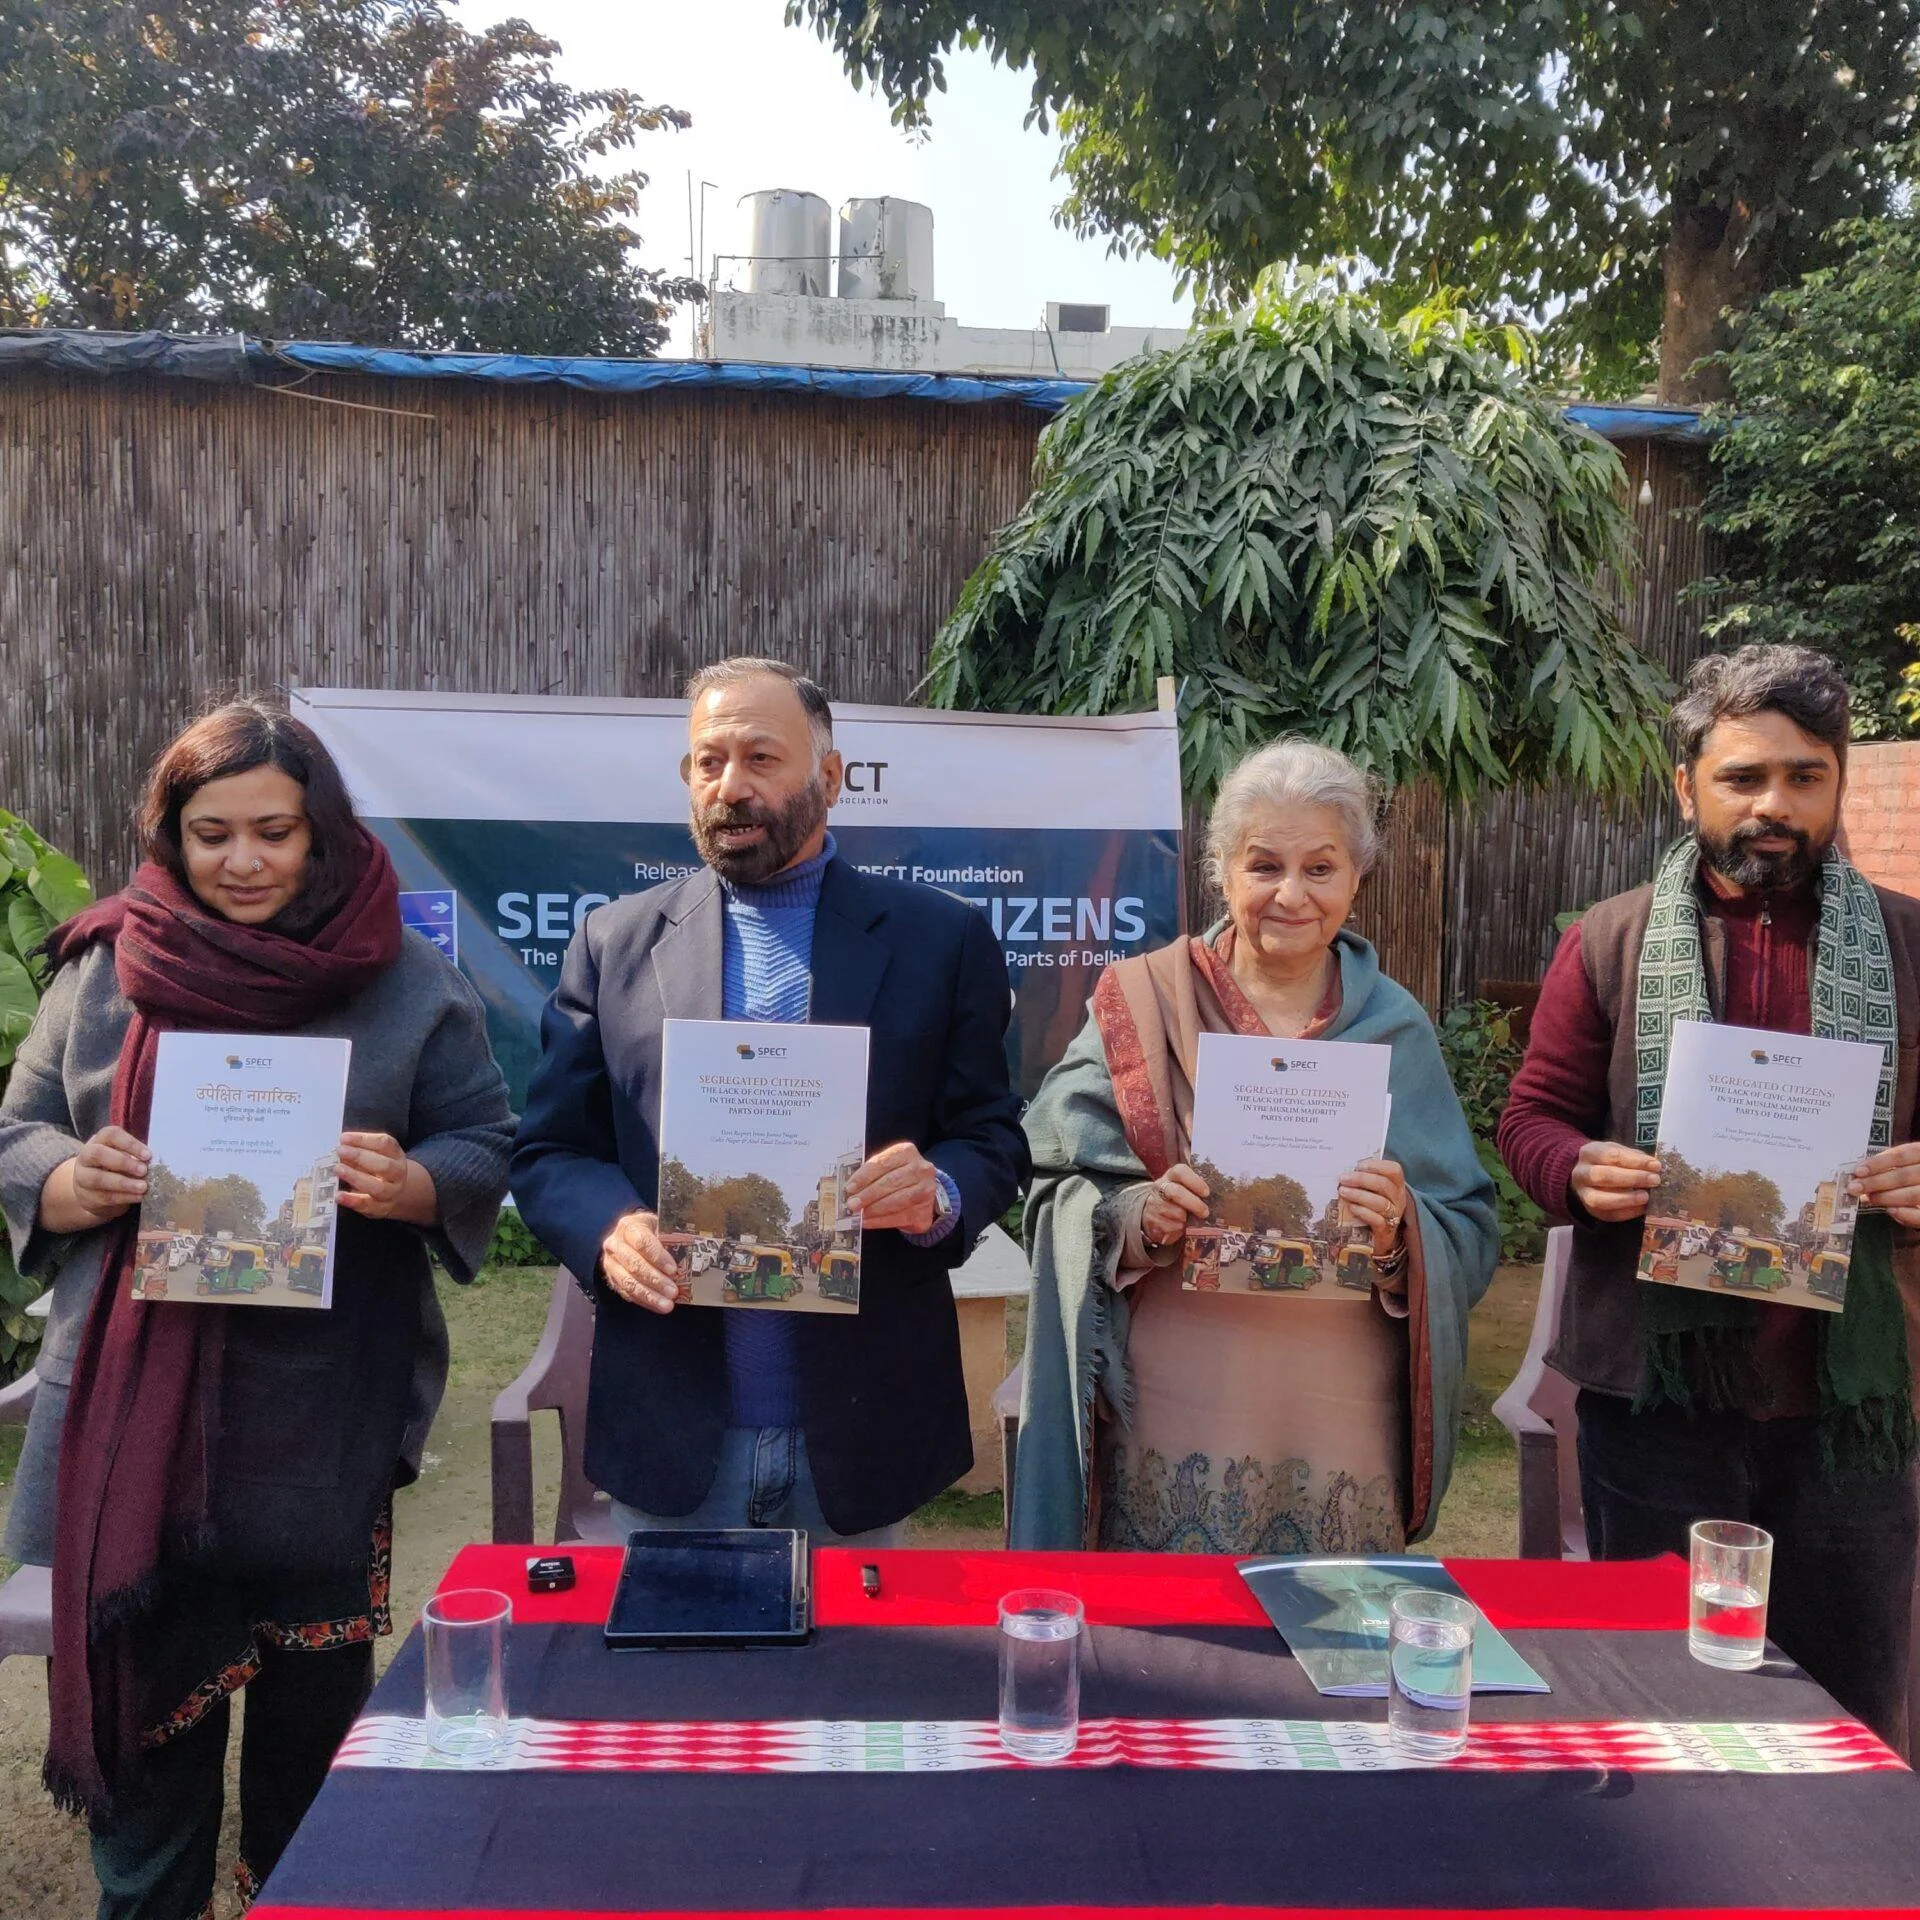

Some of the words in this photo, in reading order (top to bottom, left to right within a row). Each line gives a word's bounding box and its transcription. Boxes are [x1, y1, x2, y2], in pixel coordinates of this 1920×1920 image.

[839, 797, 889, 805] SOCIATION
[634, 862, 700, 880] Releas
[912, 866, 1024, 883] Foundation
[520, 948, 558, 966] The
[1006, 950, 1054, 967] Parts
[1059, 950, 1078, 967] of
[1082, 950, 1126, 966] Delhi
[758, 1047, 788, 1057] SPECT
[245, 1057, 273, 1066] SPECT
[1290, 1060, 1318, 1069] SPECT
[1772, 1054, 1803, 1065] SPECT
[699, 1075, 768, 1086] SEGREGATED
[1708, 1074, 1779, 1091] SEGREGATED
[196, 1083, 242, 1104] उपेक्षित
[719, 1087, 739, 1095] LACK
[741, 1088, 752, 1096] OF
[754, 1088, 777, 1096] CIVIC
[778, 1090, 822, 1098] AMENITIES
[1233, 1085, 1298, 1096] SEGREGATED
[1709, 1085, 1727, 1093] THE
[1727, 1088, 1749, 1096] LACK
[1750, 1090, 1761, 1098] OF
[1763, 1092, 1786, 1101] CIVIC
[1787, 1096, 1831, 1107] AMENITIES
[720, 1097, 736, 1105] THE
[737, 1098, 770, 1106] MUSLIM
[771, 1099, 813, 1107] MAJORITY
[1307, 1099, 1346, 1107] AMENITIES
[1727, 1096, 1744, 1105] THE
[1745, 1099, 1778, 1109] MUSLIM
[1779, 1103, 1821, 1115] MAJORITY
[729, 1107, 752, 1115] PARTS
[766, 1108, 792, 1116] DELHI
[1300, 1107, 1338, 1116] MAJORITY
[1736, 1107, 1759, 1116] PARTS
[1760, 1109, 1772, 1118] OF
[1773, 1111, 1799, 1121] DELHI
[1295, 1116, 1319, 1124] DELHI
